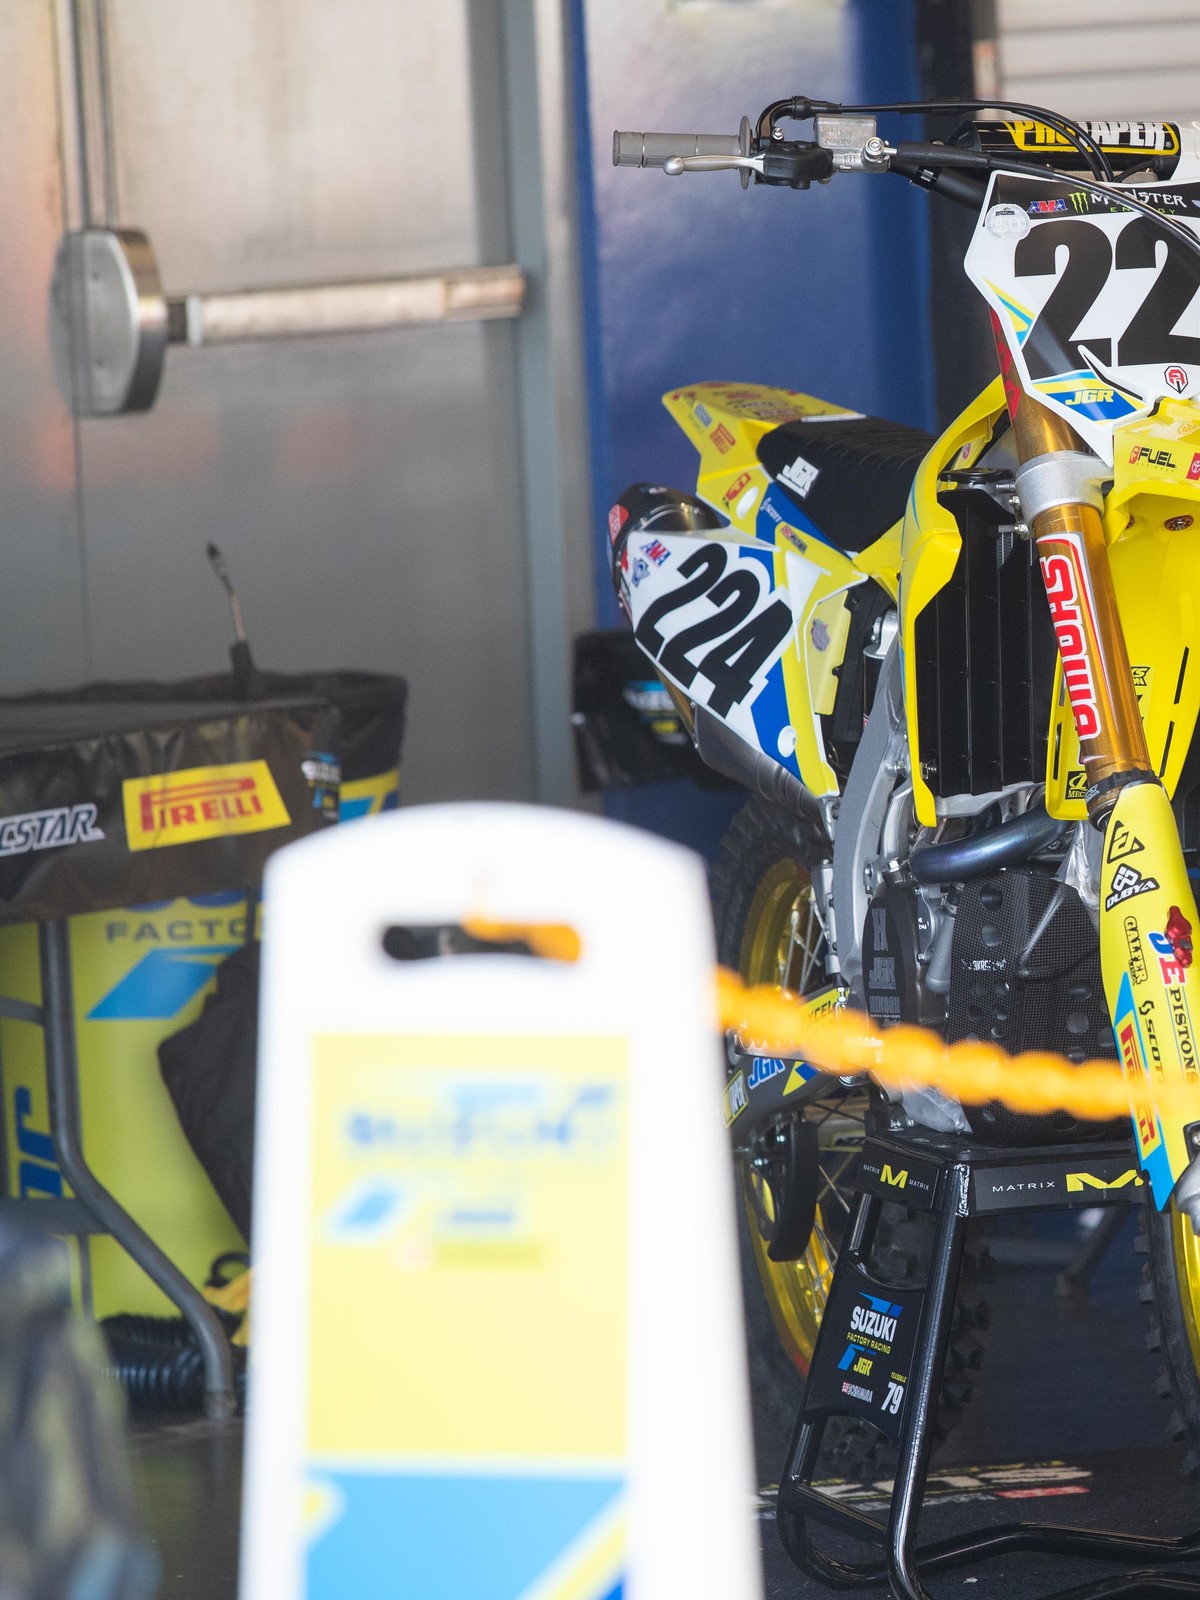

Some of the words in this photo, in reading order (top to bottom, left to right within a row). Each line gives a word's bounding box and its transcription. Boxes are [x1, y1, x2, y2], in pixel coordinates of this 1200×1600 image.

[1026, 199, 1068, 213] AMA
[1090, 188, 1187, 208] MNSTER
[1109, 206, 1176, 215] ENGY
[1065, 390, 1114, 405] JGR
[780, 456, 820, 492] JGR
[641, 539, 671, 568] AMA
[635, 543, 794, 719] 224
[1040, 555, 1102, 740] SHOWA
[139, 776, 262, 833] PIRELLI
[1106, 881, 1157, 909] DUBYA
[1124, 916, 1148, 985] GALFER
[1169, 988, 1199, 1084] PISTONS
[1145, 1018, 1165, 1085] SCOT
[748, 1058, 786, 1090] JGR
[863, 1164, 881, 1174] MATRIX
[879, 1164, 909, 1189] M
[908, 1179, 930, 1191] MATRIX
[992, 1181, 1056, 1193] MATRIX
[850, 1305, 898, 1343] SUZUKI
[847, 1332, 871, 1348] FACTORY
[870, 1340, 891, 1354] RACING
[853, 1357, 873, 1376] JGR
[880, 1381, 905, 1415] 79
